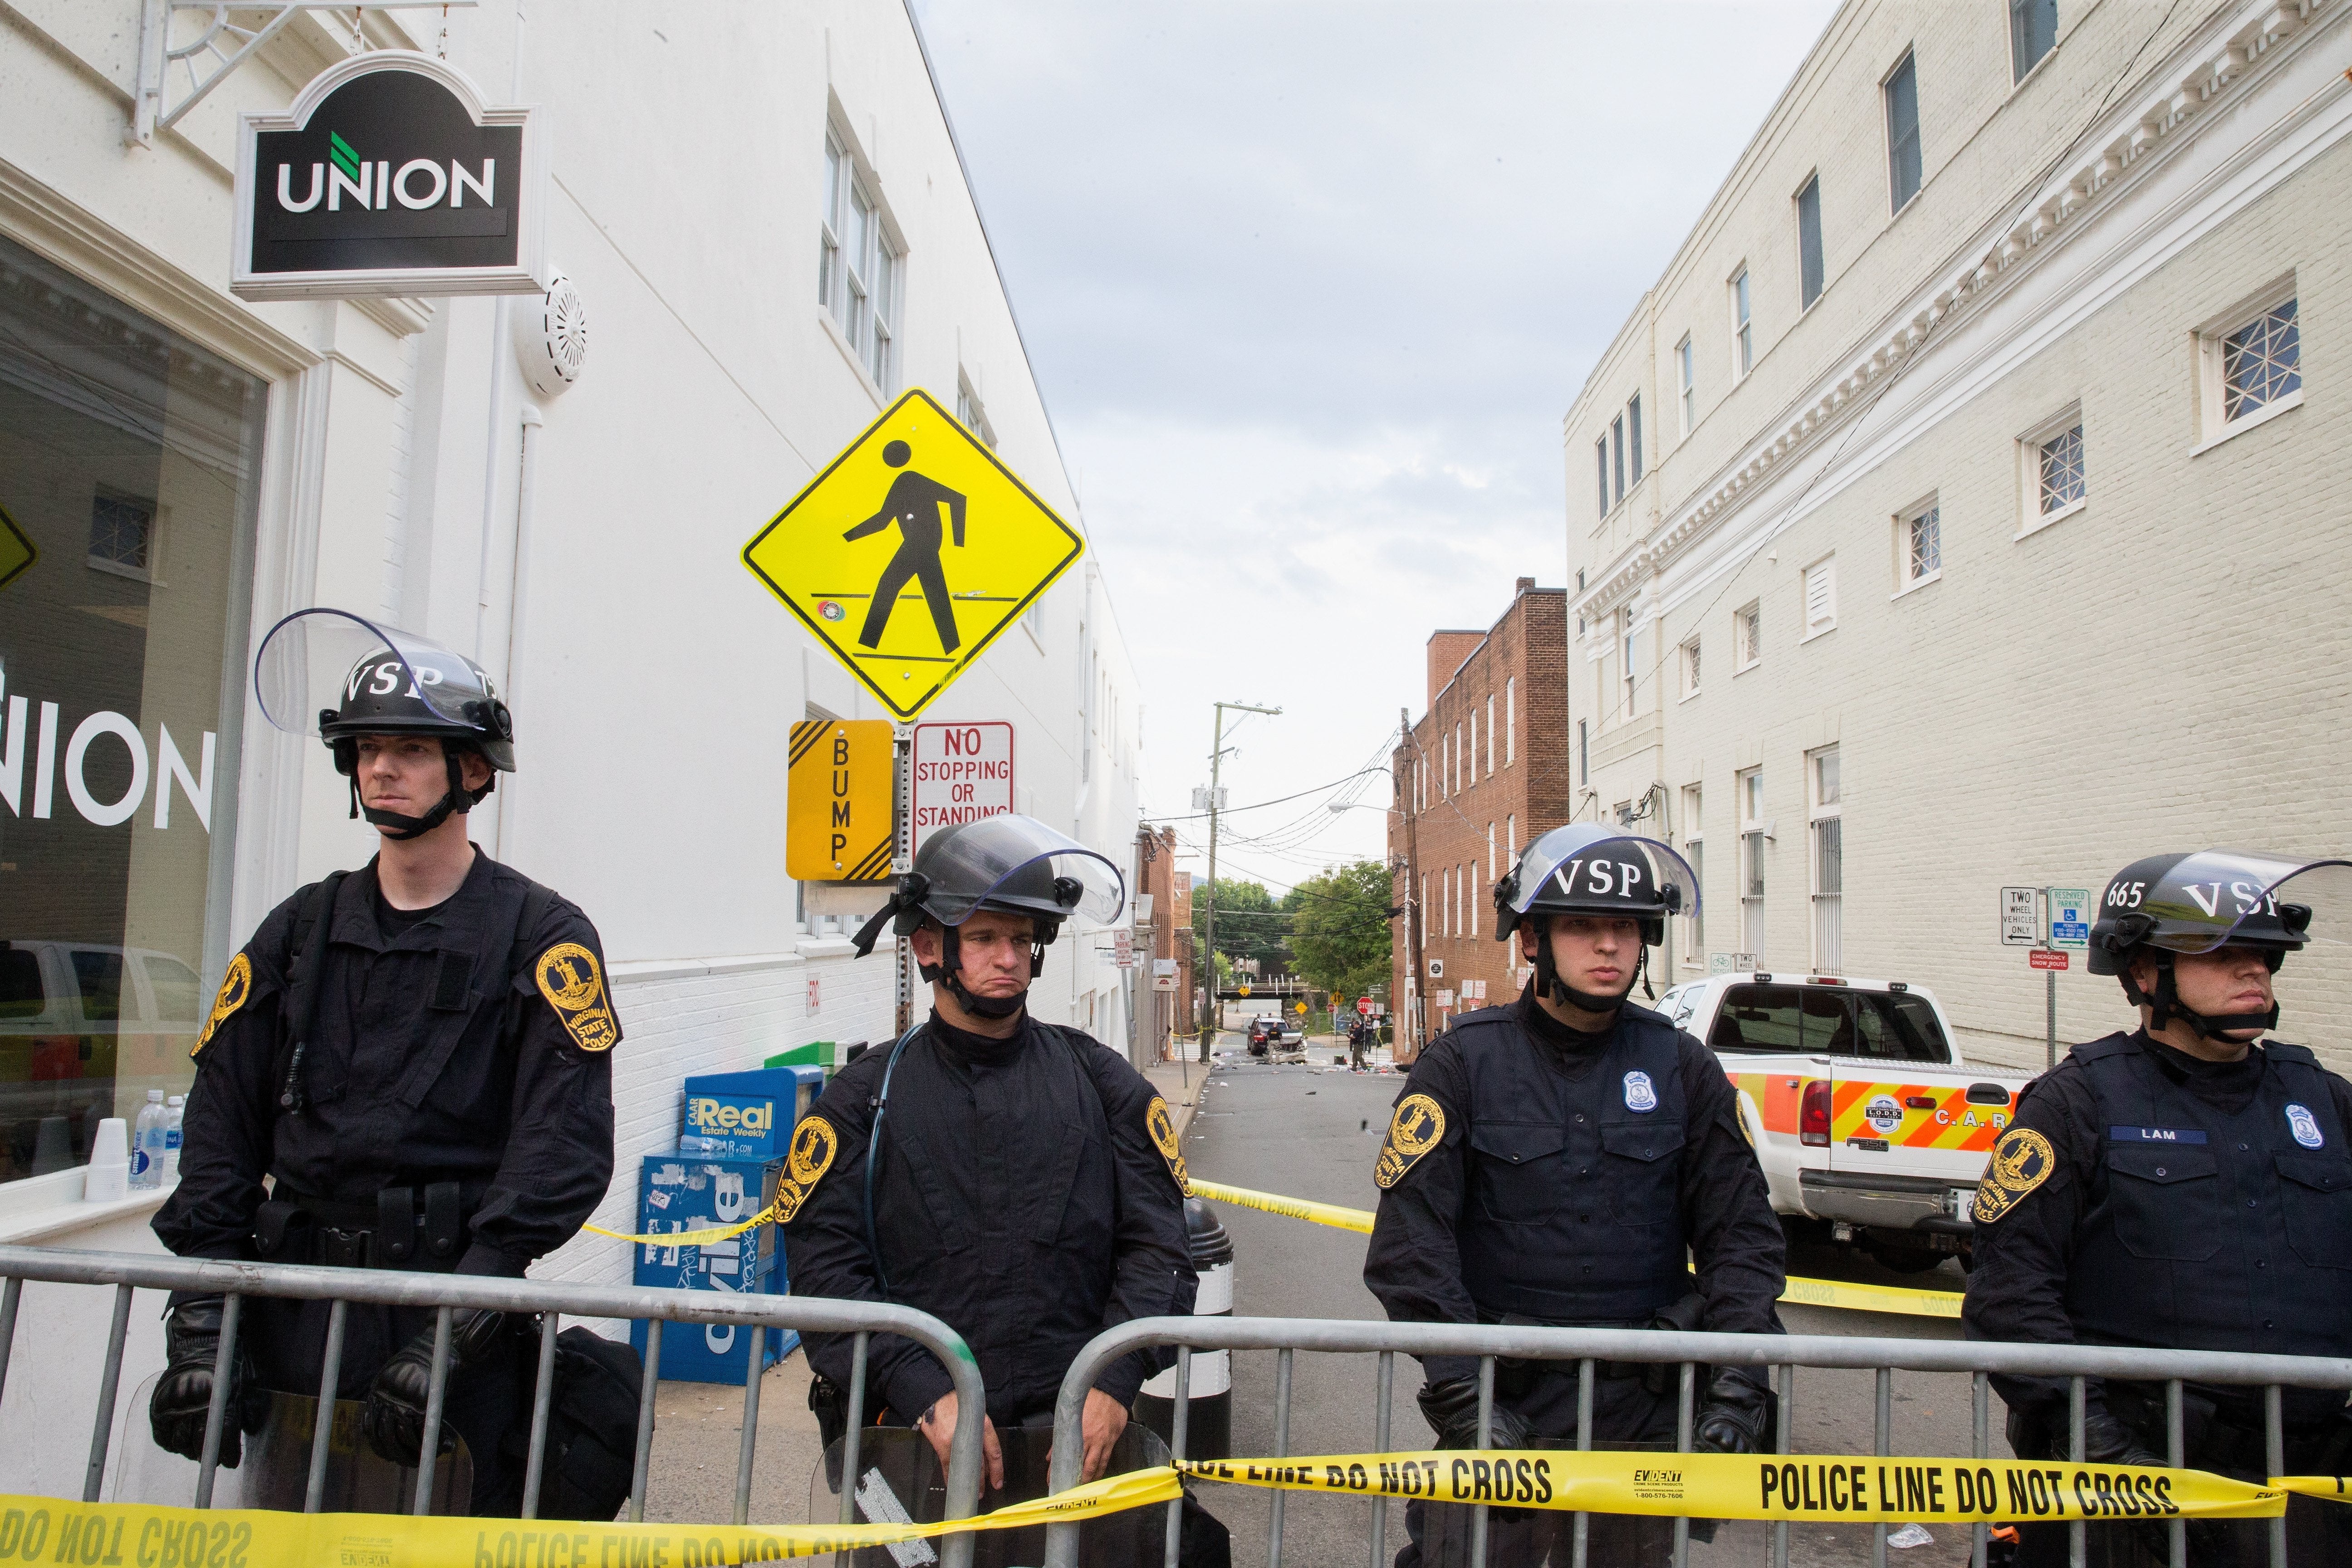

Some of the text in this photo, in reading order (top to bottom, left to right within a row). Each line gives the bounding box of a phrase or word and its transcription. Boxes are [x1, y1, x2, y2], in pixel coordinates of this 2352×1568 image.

[277, 158, 495, 213] UNION
[348, 662, 444, 701] VSP
[944, 728, 981, 756] NO
[918, 760, 1009, 781] STOPPING
[831, 738, 850, 861] BUMP
[951, 784, 974, 803] OR
[1554, 859, 1641, 898] VSP
[2010, 892, 2030, 903] TWO
[2054, 892, 2085, 900] RESERVED
[2057, 900, 2083, 908] PARKING
[2107, 882, 2146, 908] 665
[2181, 881, 2278, 917] VSP
[2003, 916, 2037, 924] VEHICLES
[2010, 906, 2032, 914] WHEEL
[2011, 926, 2030, 934] ONLY
[548, 952, 578, 967] VIRGINIA
[809, 980, 819, 1007] FDC
[568, 1008, 608, 1030] VIRGINIA
[576, 1018, 608, 1039] STATE
[583, 1028, 613, 1048] POLICE
[687, 1098, 699, 1126] CAAR
[697, 1098, 773, 1130] Real
[1414, 1103, 1435, 1122] VIRGINIA
[701, 1126, 767, 1139] Estate Weekly
[807, 1126, 828, 1143] VIRGINIA
[2141, 1129, 2176, 1140] LAM
[2020, 1137, 2043, 1159] VIRGINIA
[1380, 1156, 1397, 1176] STATE
[1384, 1146, 1406, 1174] VIRGINIA
[1376, 1164, 1392, 1186] POLICE
[778, 1188, 796, 1210] STATE
[781, 1179, 803, 1205] VIRGINIA
[1979, 1187, 2000, 1212] STATE
[1983, 1178, 2010, 1209] VIRGINIA
[774, 1198, 790, 1220] POLICE
[1975, 1196, 1994, 1220] POLICE
[1326, 1463, 1368, 1490] DO
[1379, 1460, 1440, 1497] NOT
[1452, 1458, 1553, 1504] CROSS
[1634, 1470, 1682, 1482] EVIDENT
[1760, 1463, 2180, 1517] POLICE LINE DO NOT CROSS
